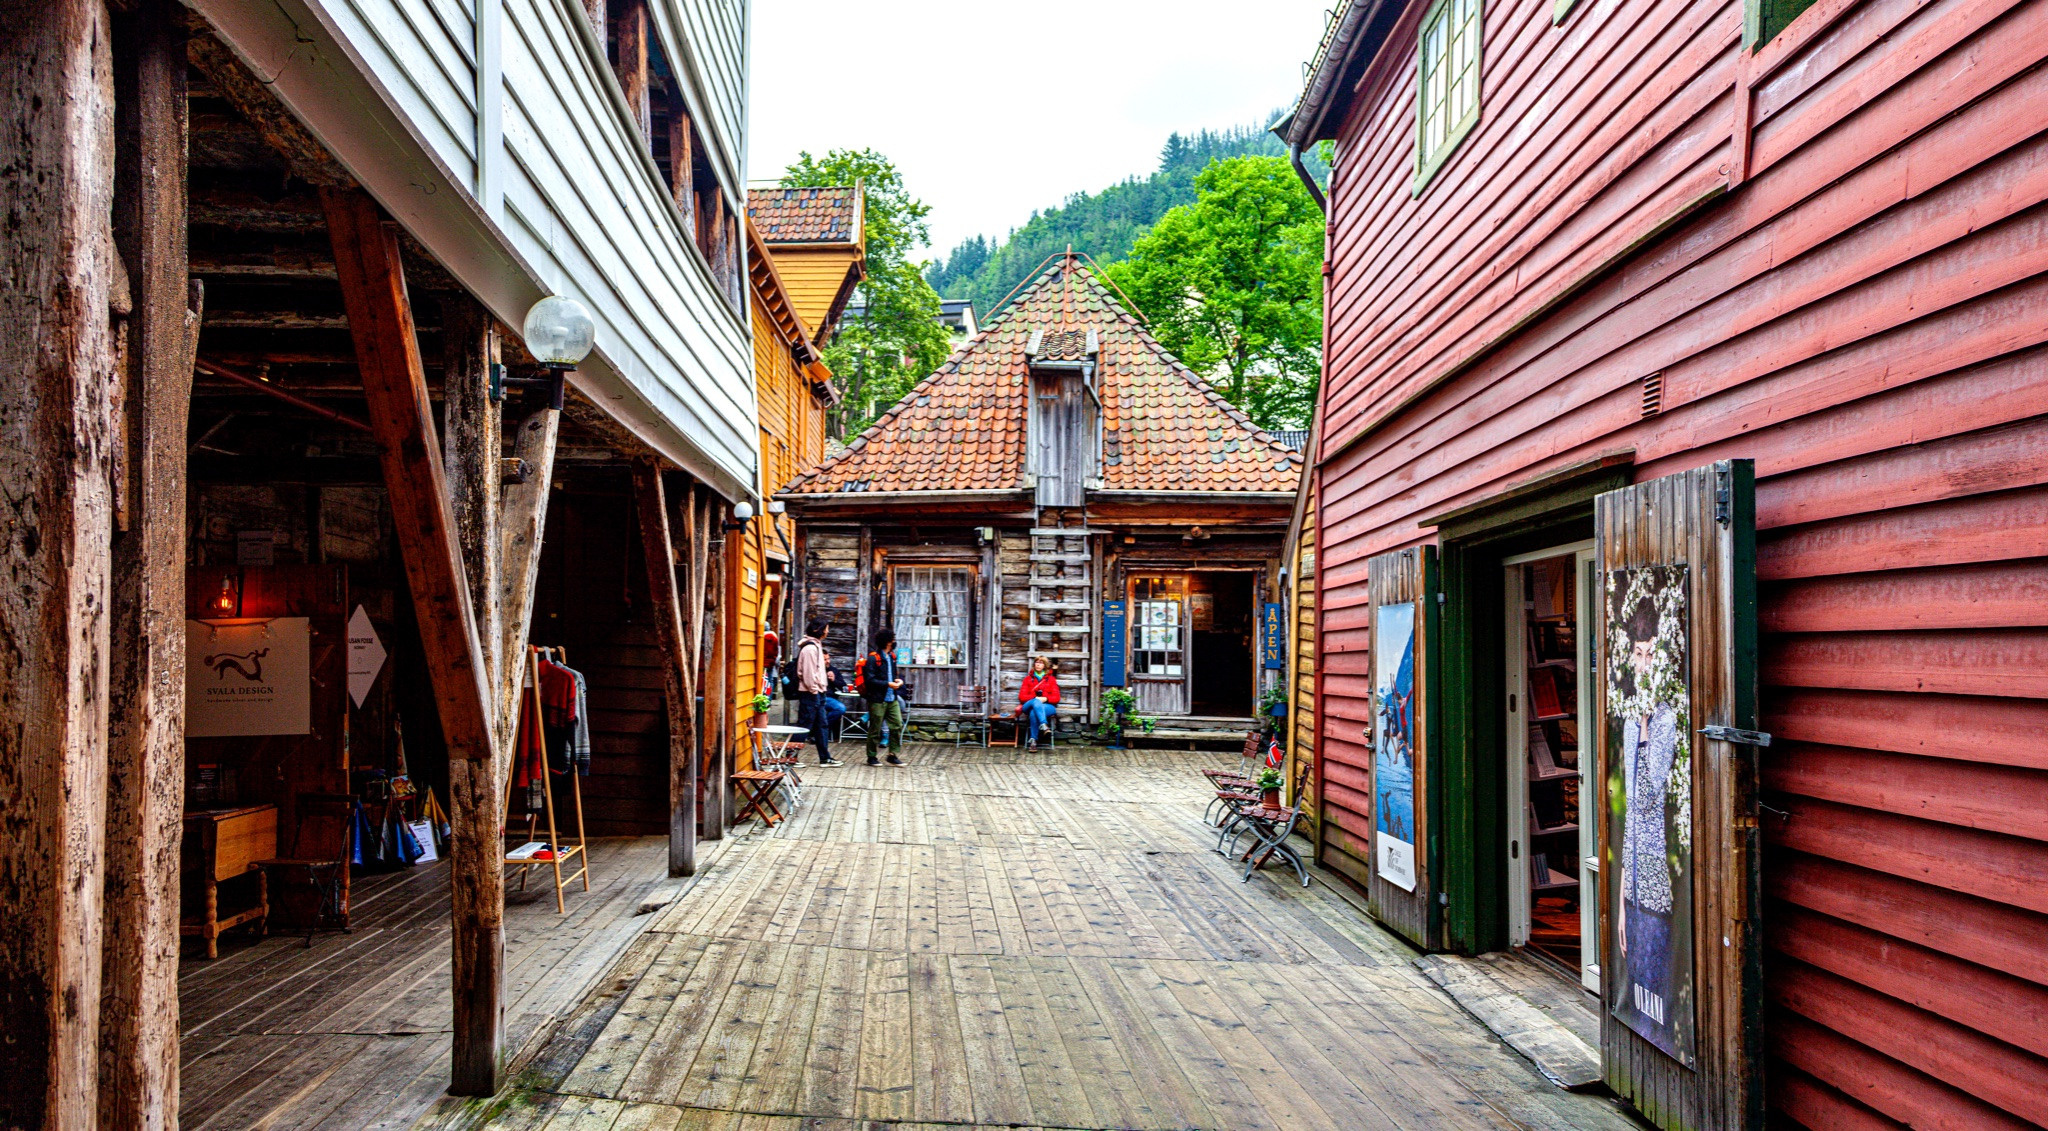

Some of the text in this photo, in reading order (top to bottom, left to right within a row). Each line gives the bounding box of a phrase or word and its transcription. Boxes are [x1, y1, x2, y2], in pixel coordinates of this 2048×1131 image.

[1267, 607, 1278, 660] ÅPEN
[206, 686, 274, 696] SVALA DESIGN
[1634, 983, 1664, 1025] OLEANA
